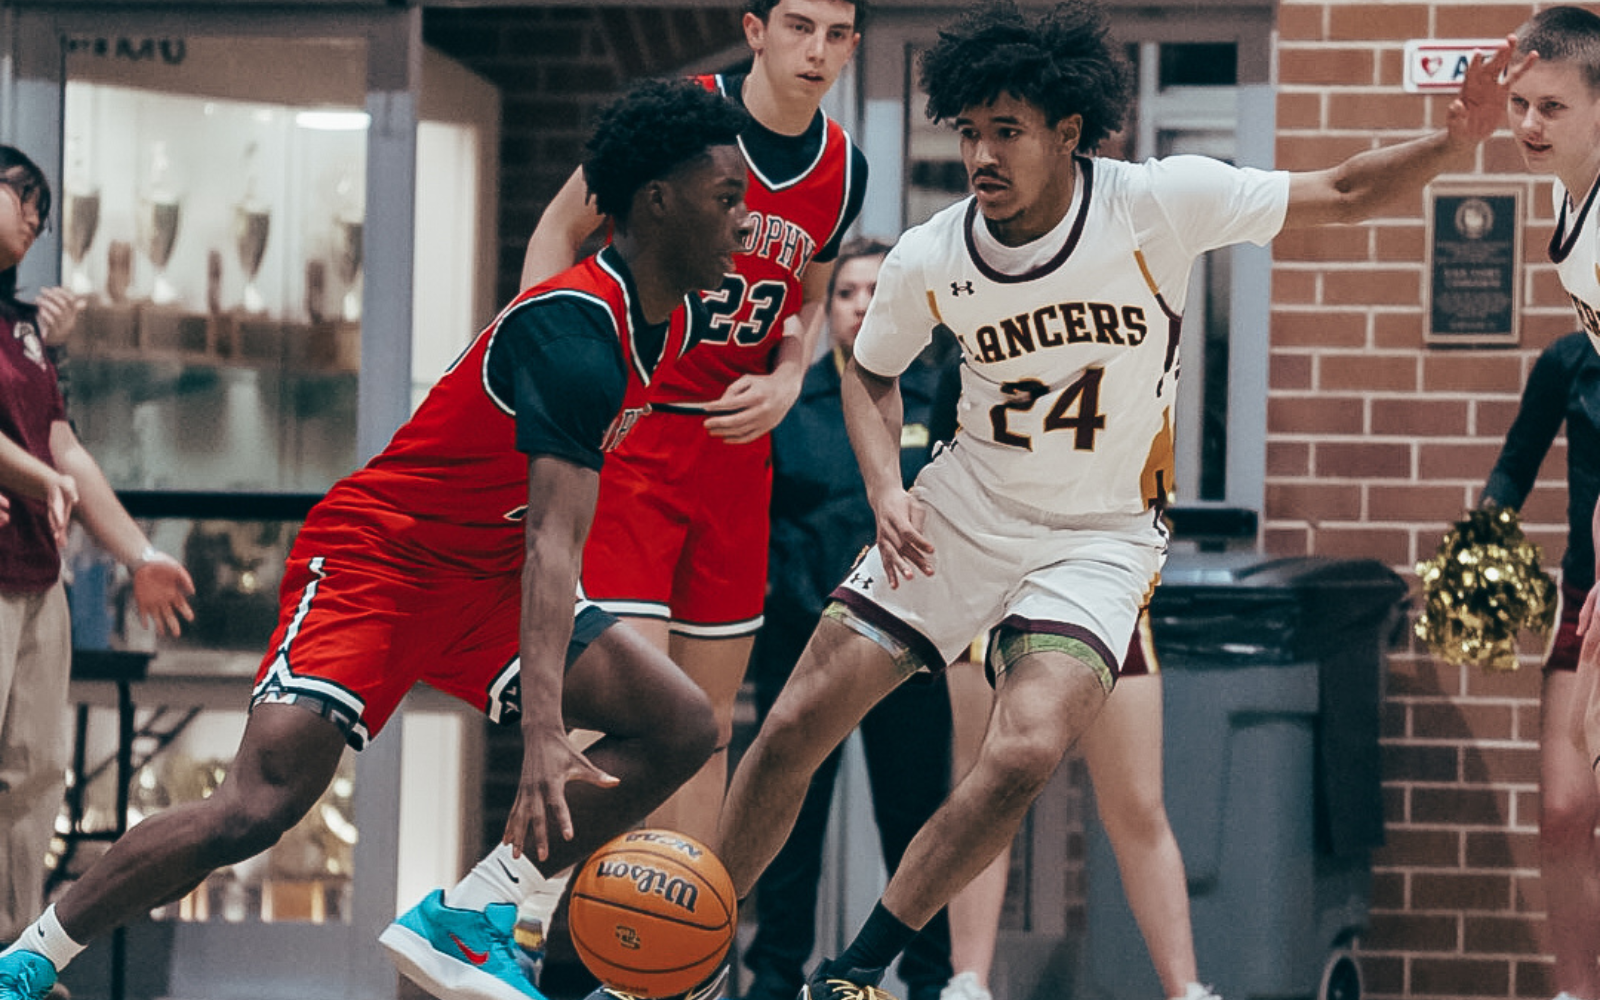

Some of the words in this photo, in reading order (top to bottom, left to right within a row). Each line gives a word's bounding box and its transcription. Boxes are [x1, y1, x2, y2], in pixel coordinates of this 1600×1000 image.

[744, 211, 816, 282] OPHY
[701, 272, 788, 347] 23
[989, 366, 1107, 452] 24
[596, 861, 699, 914] Wilson
